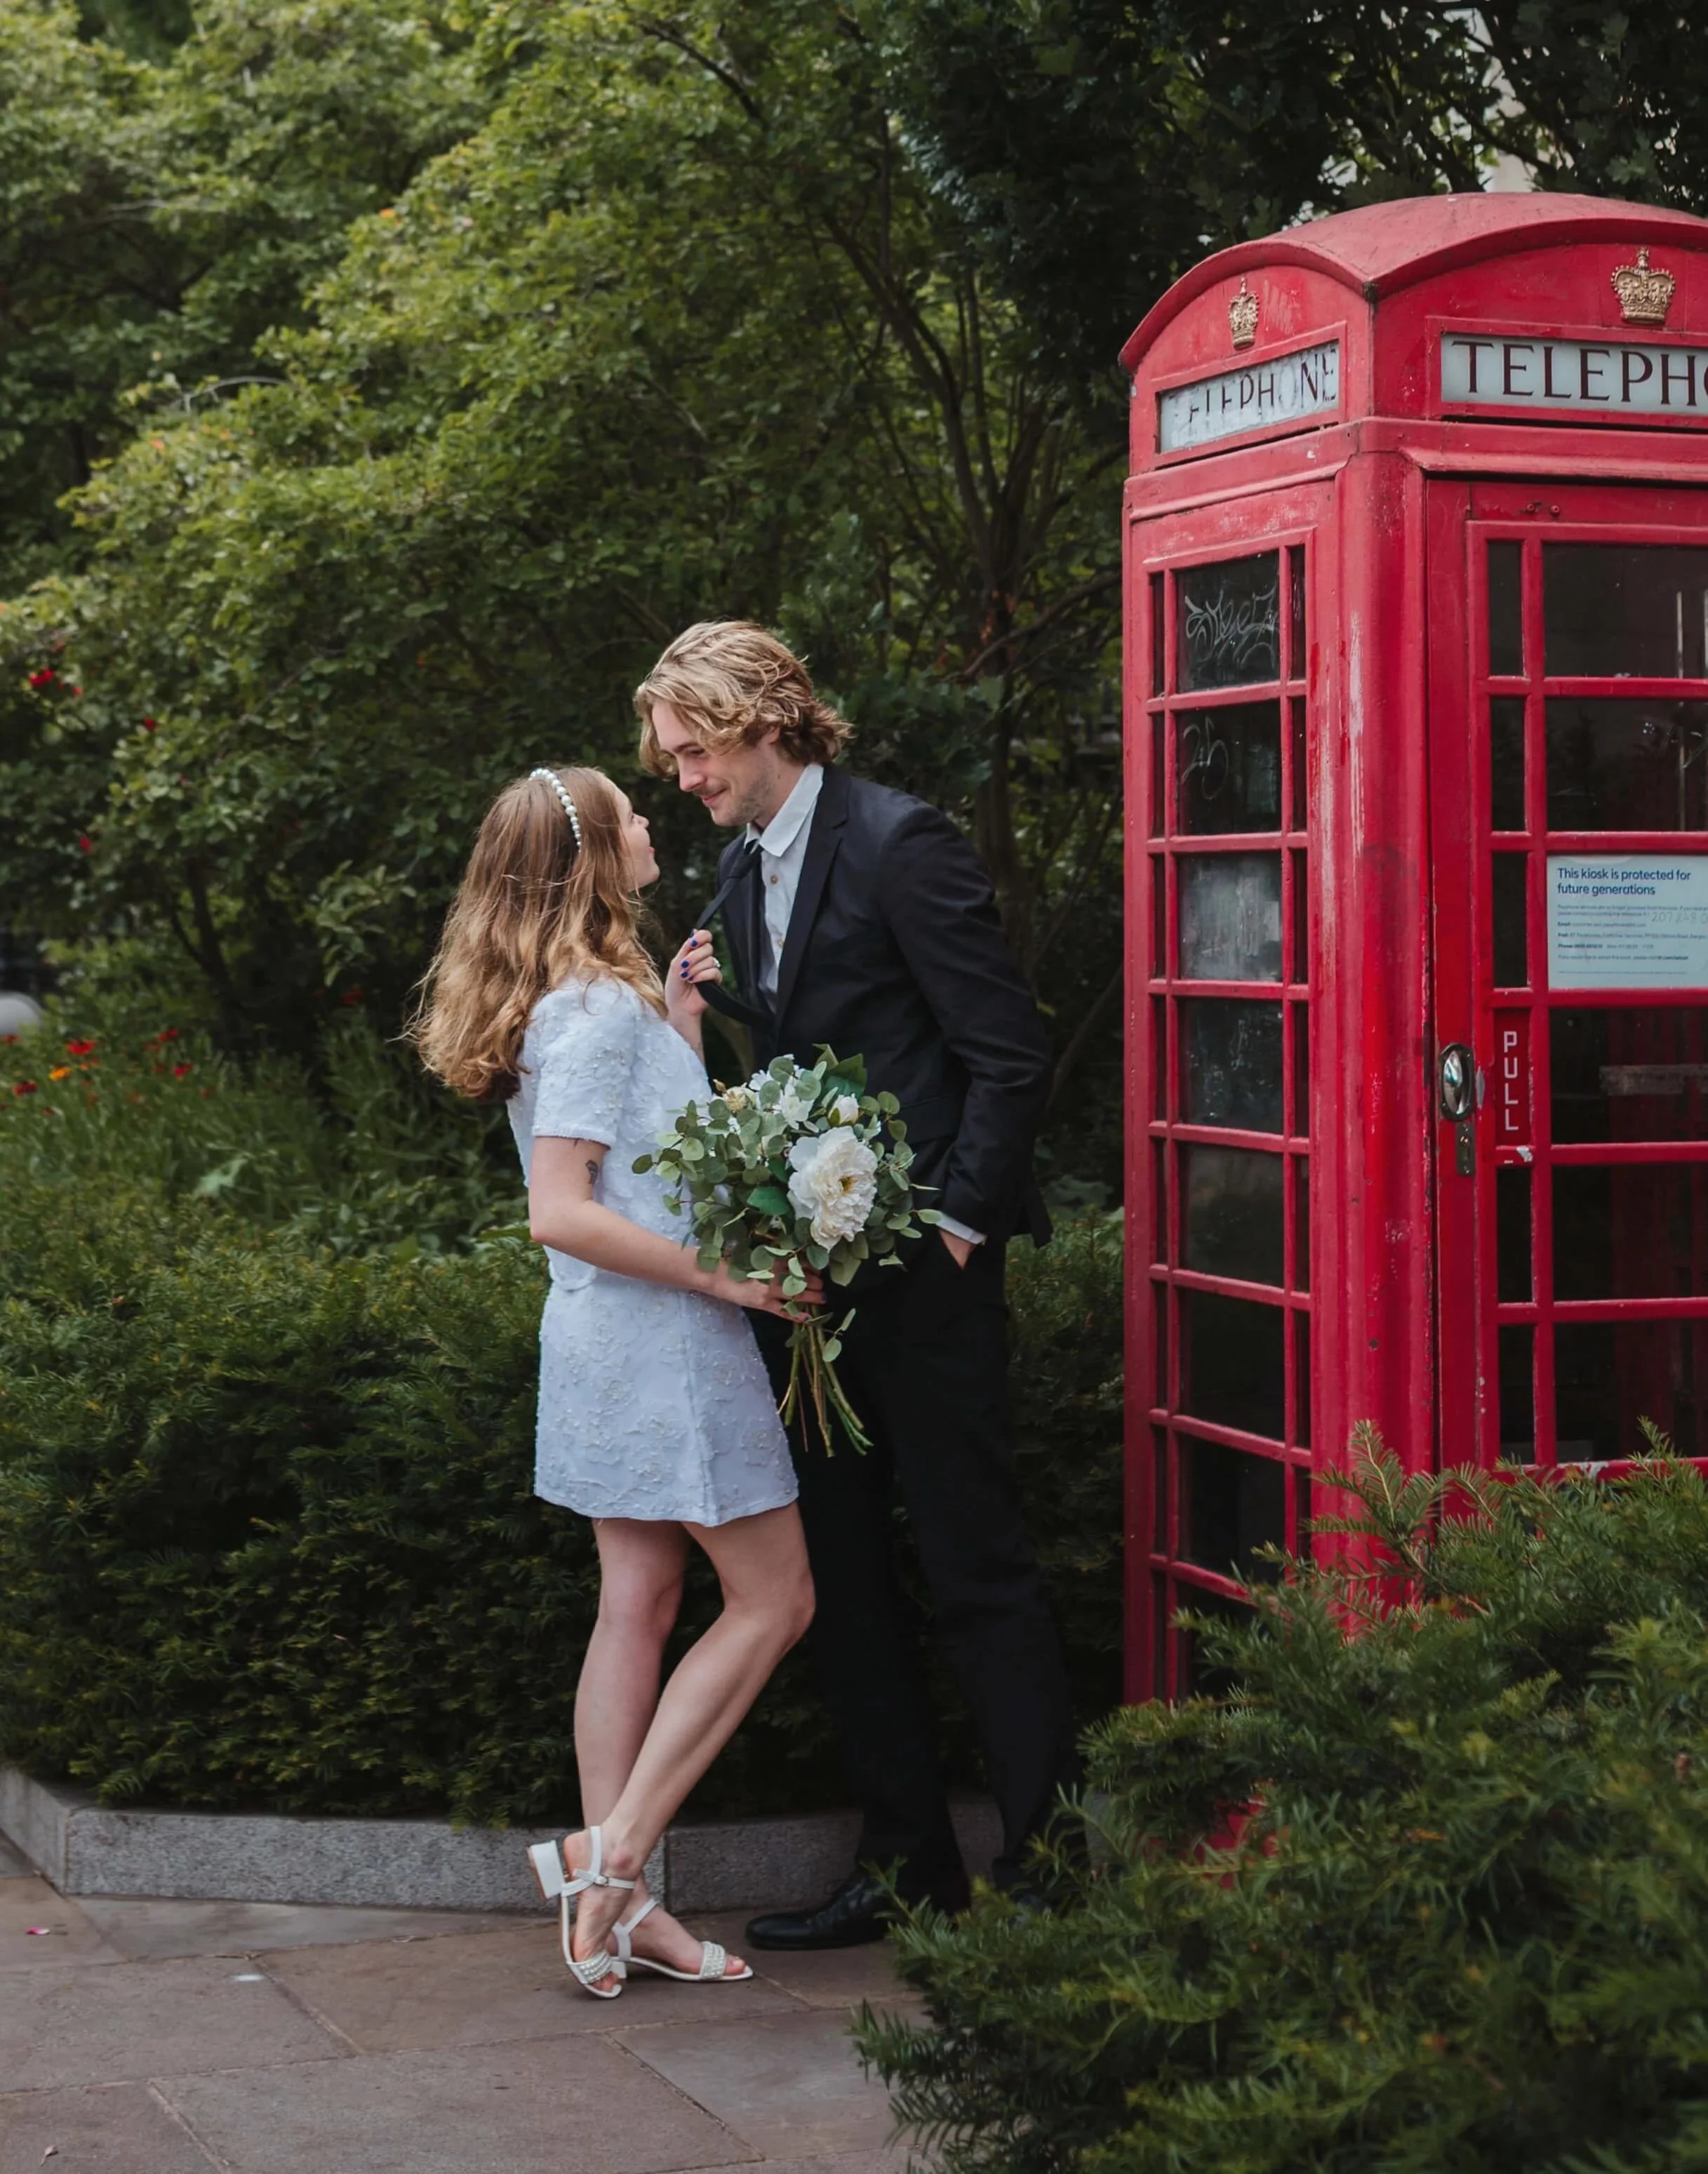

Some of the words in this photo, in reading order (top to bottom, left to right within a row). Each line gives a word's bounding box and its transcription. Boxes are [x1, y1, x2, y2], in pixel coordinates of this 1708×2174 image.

[1451, 340, 1708, 407] TELEPH
[1557, 867, 1579, 879] This
[1581, 868, 1608, 879] kiosk
[1611, 869, 1619, 879] is
[1621, 869, 1674, 881] protected
[1676, 869, 1691, 881] for
[1557, 883, 1589, 894] future
[1592, 883, 1656, 897] generations
[1504, 1030, 1519, 1131] PULL
